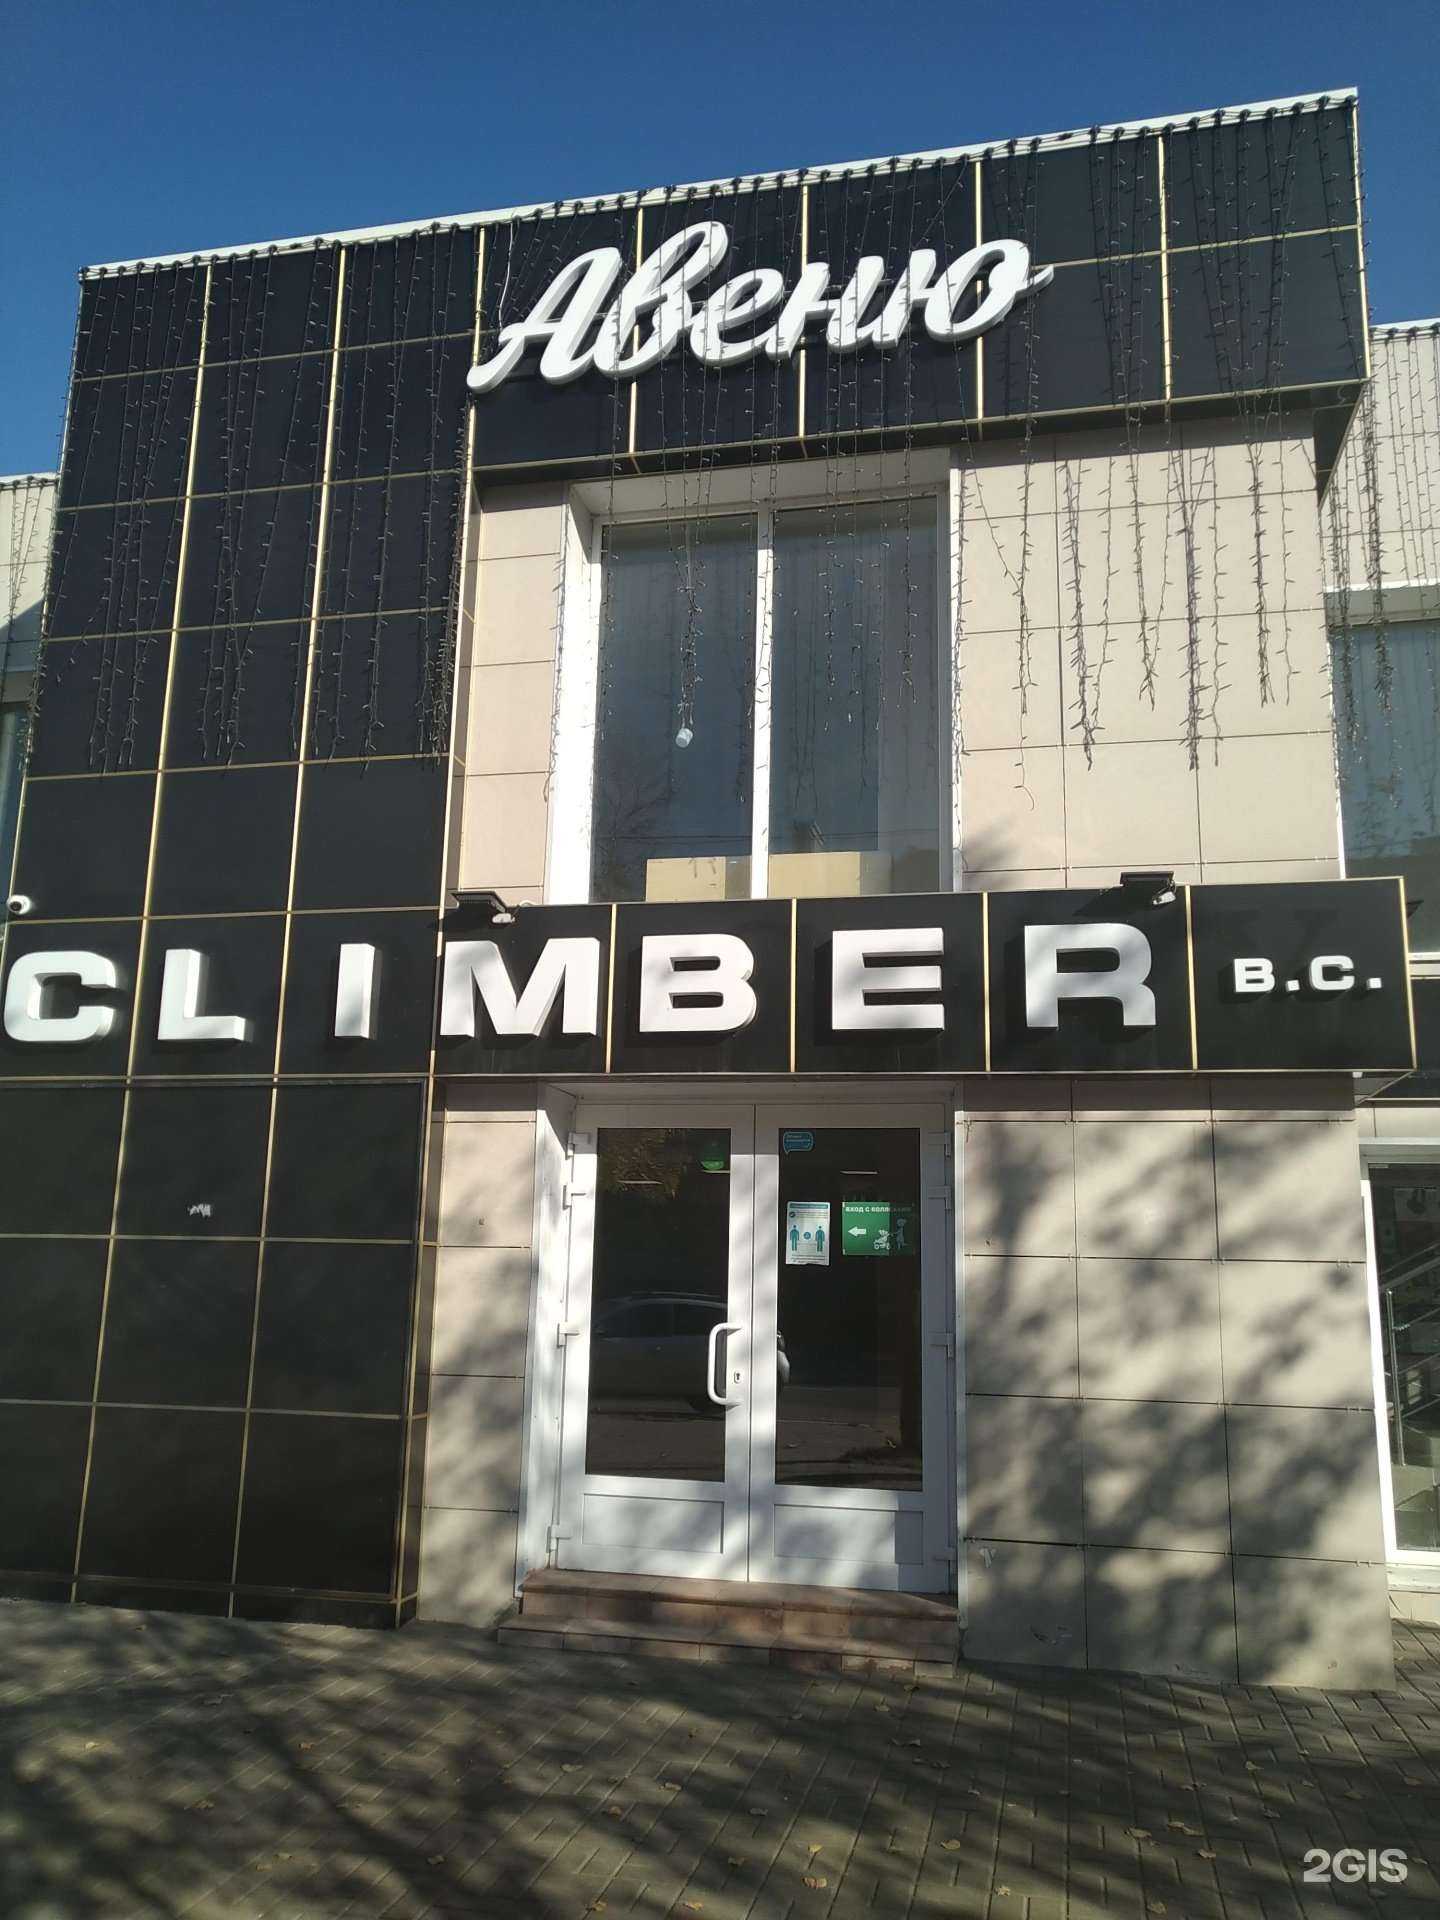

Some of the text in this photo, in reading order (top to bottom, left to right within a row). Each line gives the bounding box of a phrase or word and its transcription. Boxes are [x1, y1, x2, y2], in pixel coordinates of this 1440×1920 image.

[466, 220, 1054, 393] Авеню
[4, 922, 1383, 1043] CLIMBER B.C.
